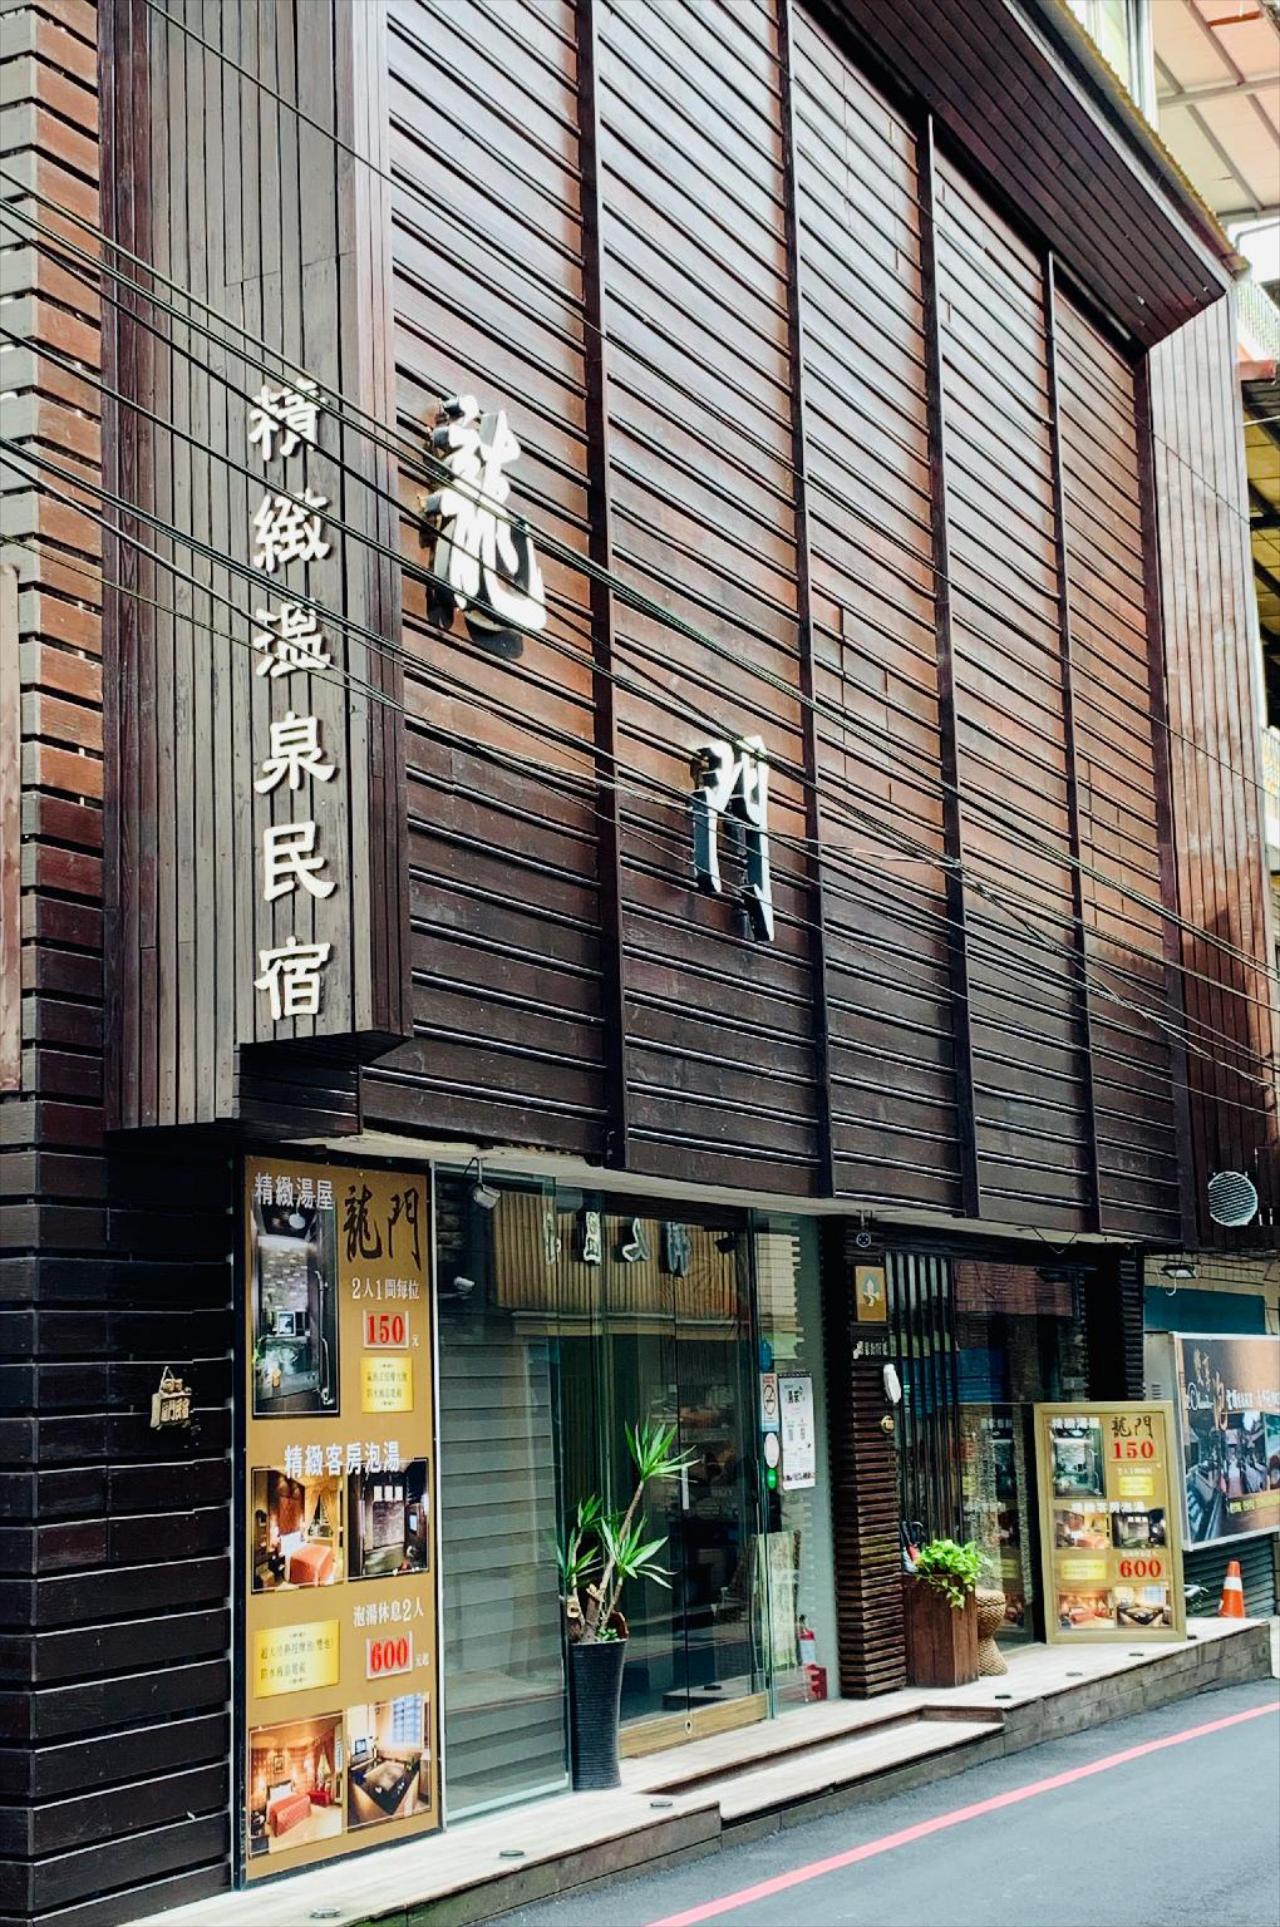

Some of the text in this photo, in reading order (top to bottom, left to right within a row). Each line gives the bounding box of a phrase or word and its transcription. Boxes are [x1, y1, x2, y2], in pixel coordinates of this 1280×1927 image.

[255, 1172, 333, 1211] 精緻湯屋
[343, 1185, 421, 1271] 龍門
[367, 1314, 405, 1345] 150
[1111, 1414, 1153, 1438] 龍門
[284, 1441, 400, 1478] 精緻客房泡湯
[1112, 1440, 1154, 1460] 150
[1119, 1559, 1162, 1579] 600
[370, 1637, 408, 1673] 600
